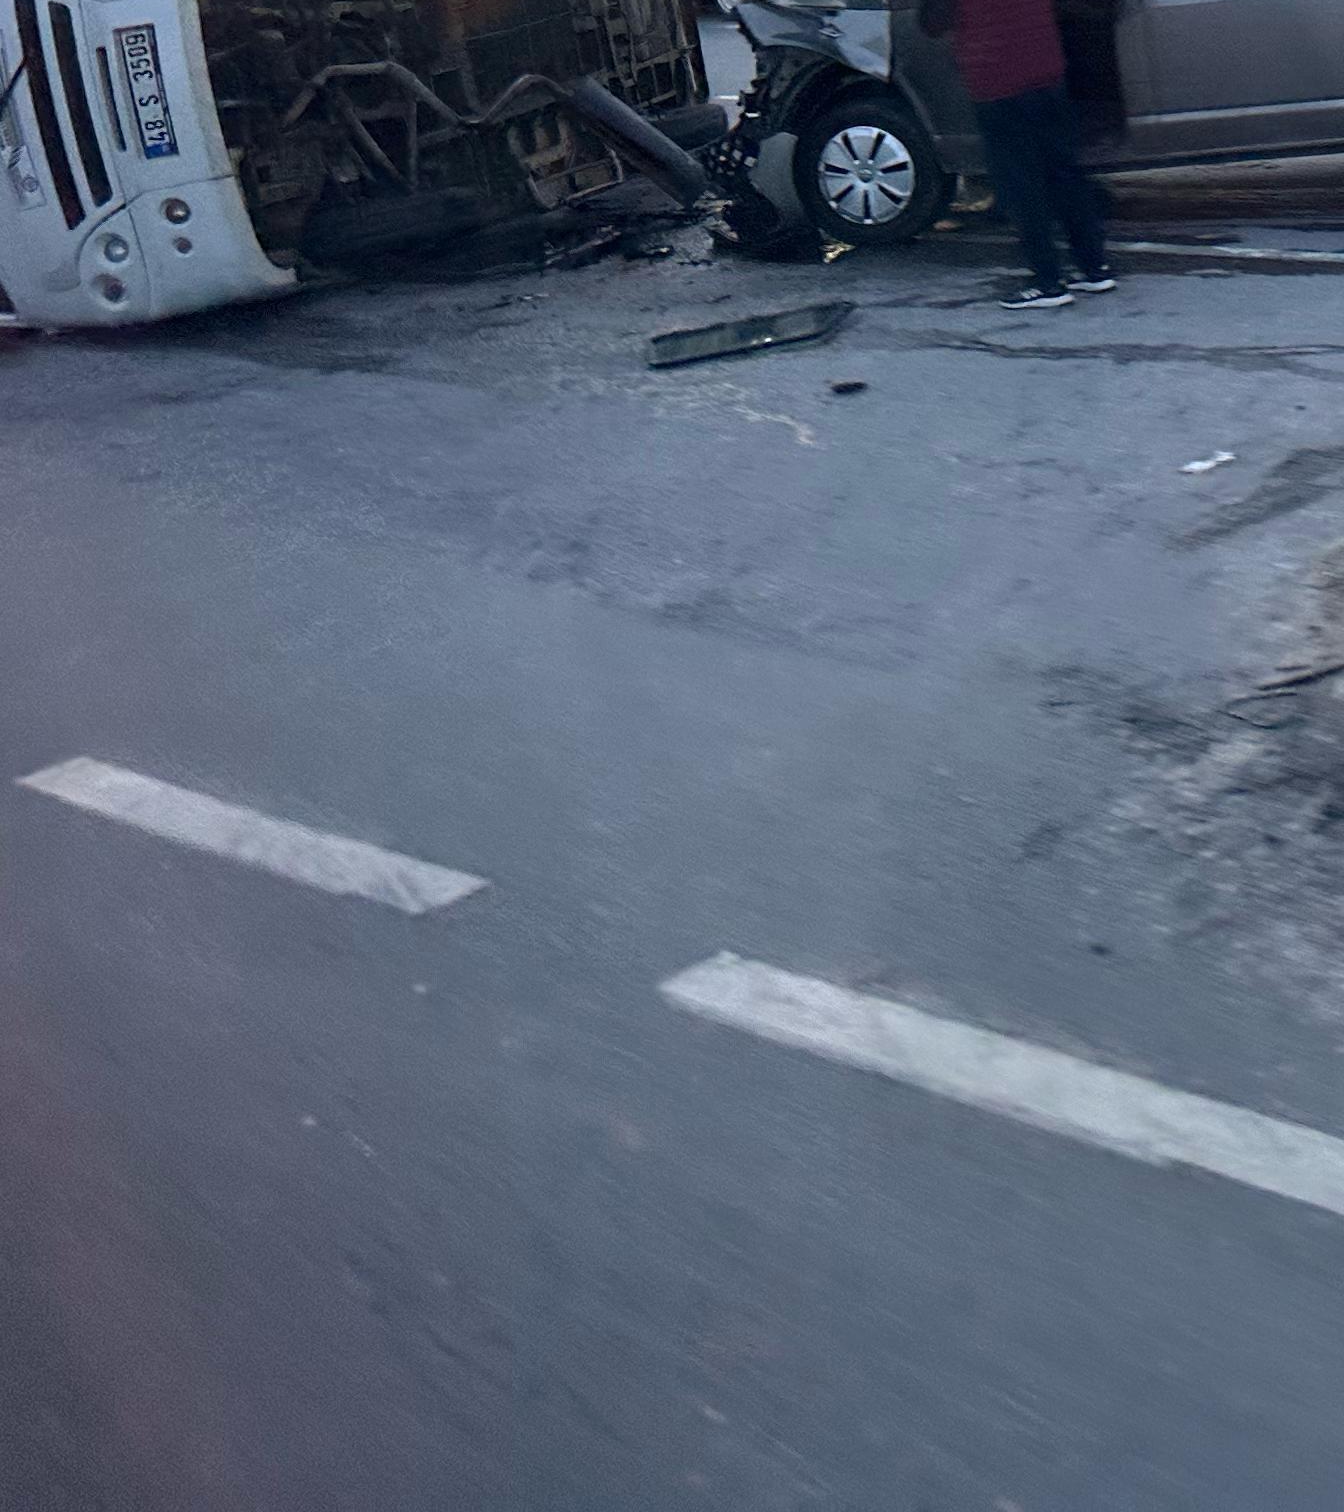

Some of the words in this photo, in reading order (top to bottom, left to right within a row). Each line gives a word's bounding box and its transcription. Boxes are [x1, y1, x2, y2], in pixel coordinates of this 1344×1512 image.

[125, 32, 154, 85] 3509
[138, 94, 159, 107] S
[145, 119, 168, 142] 48
